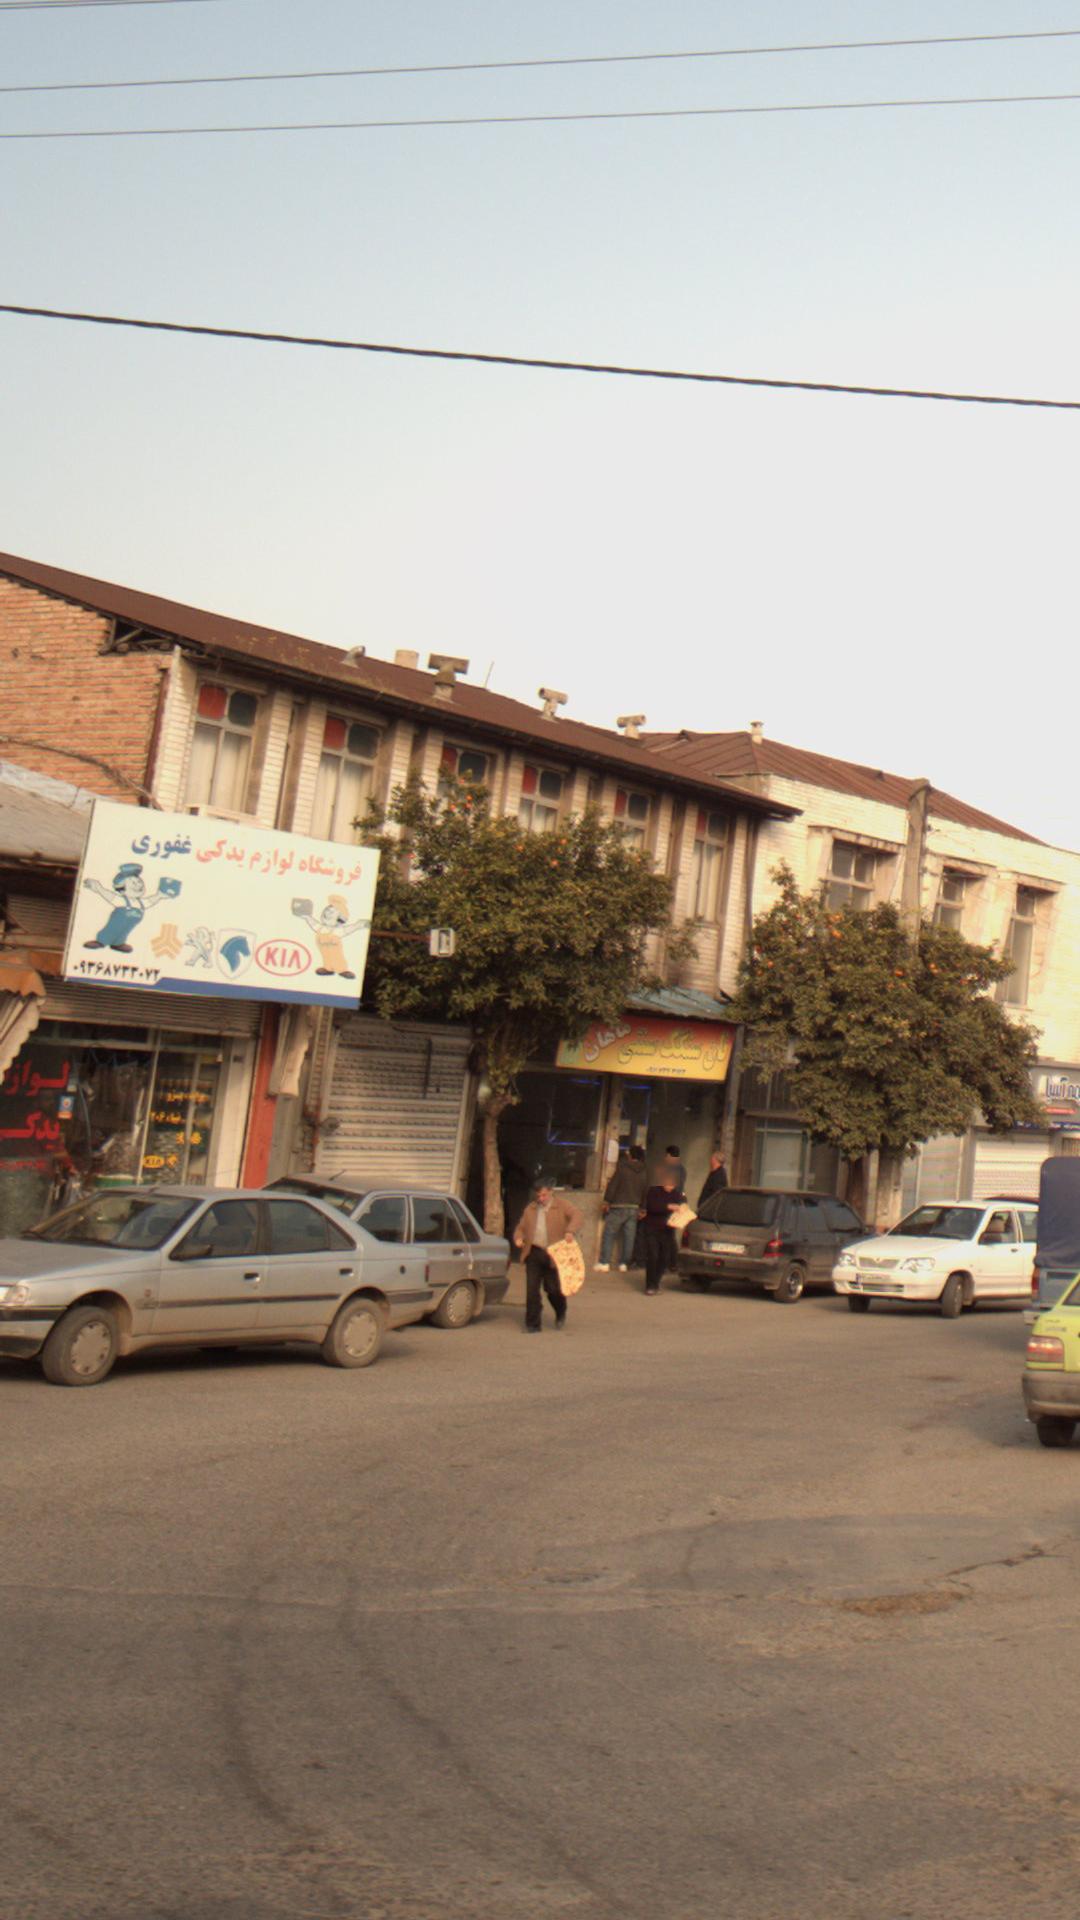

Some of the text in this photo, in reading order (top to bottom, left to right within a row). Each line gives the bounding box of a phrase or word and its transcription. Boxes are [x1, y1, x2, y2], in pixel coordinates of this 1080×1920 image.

[131, 833, 362, 886] فروشگاه لوازم یدکی غفوری
[264, 946, 301, 969] KIA
